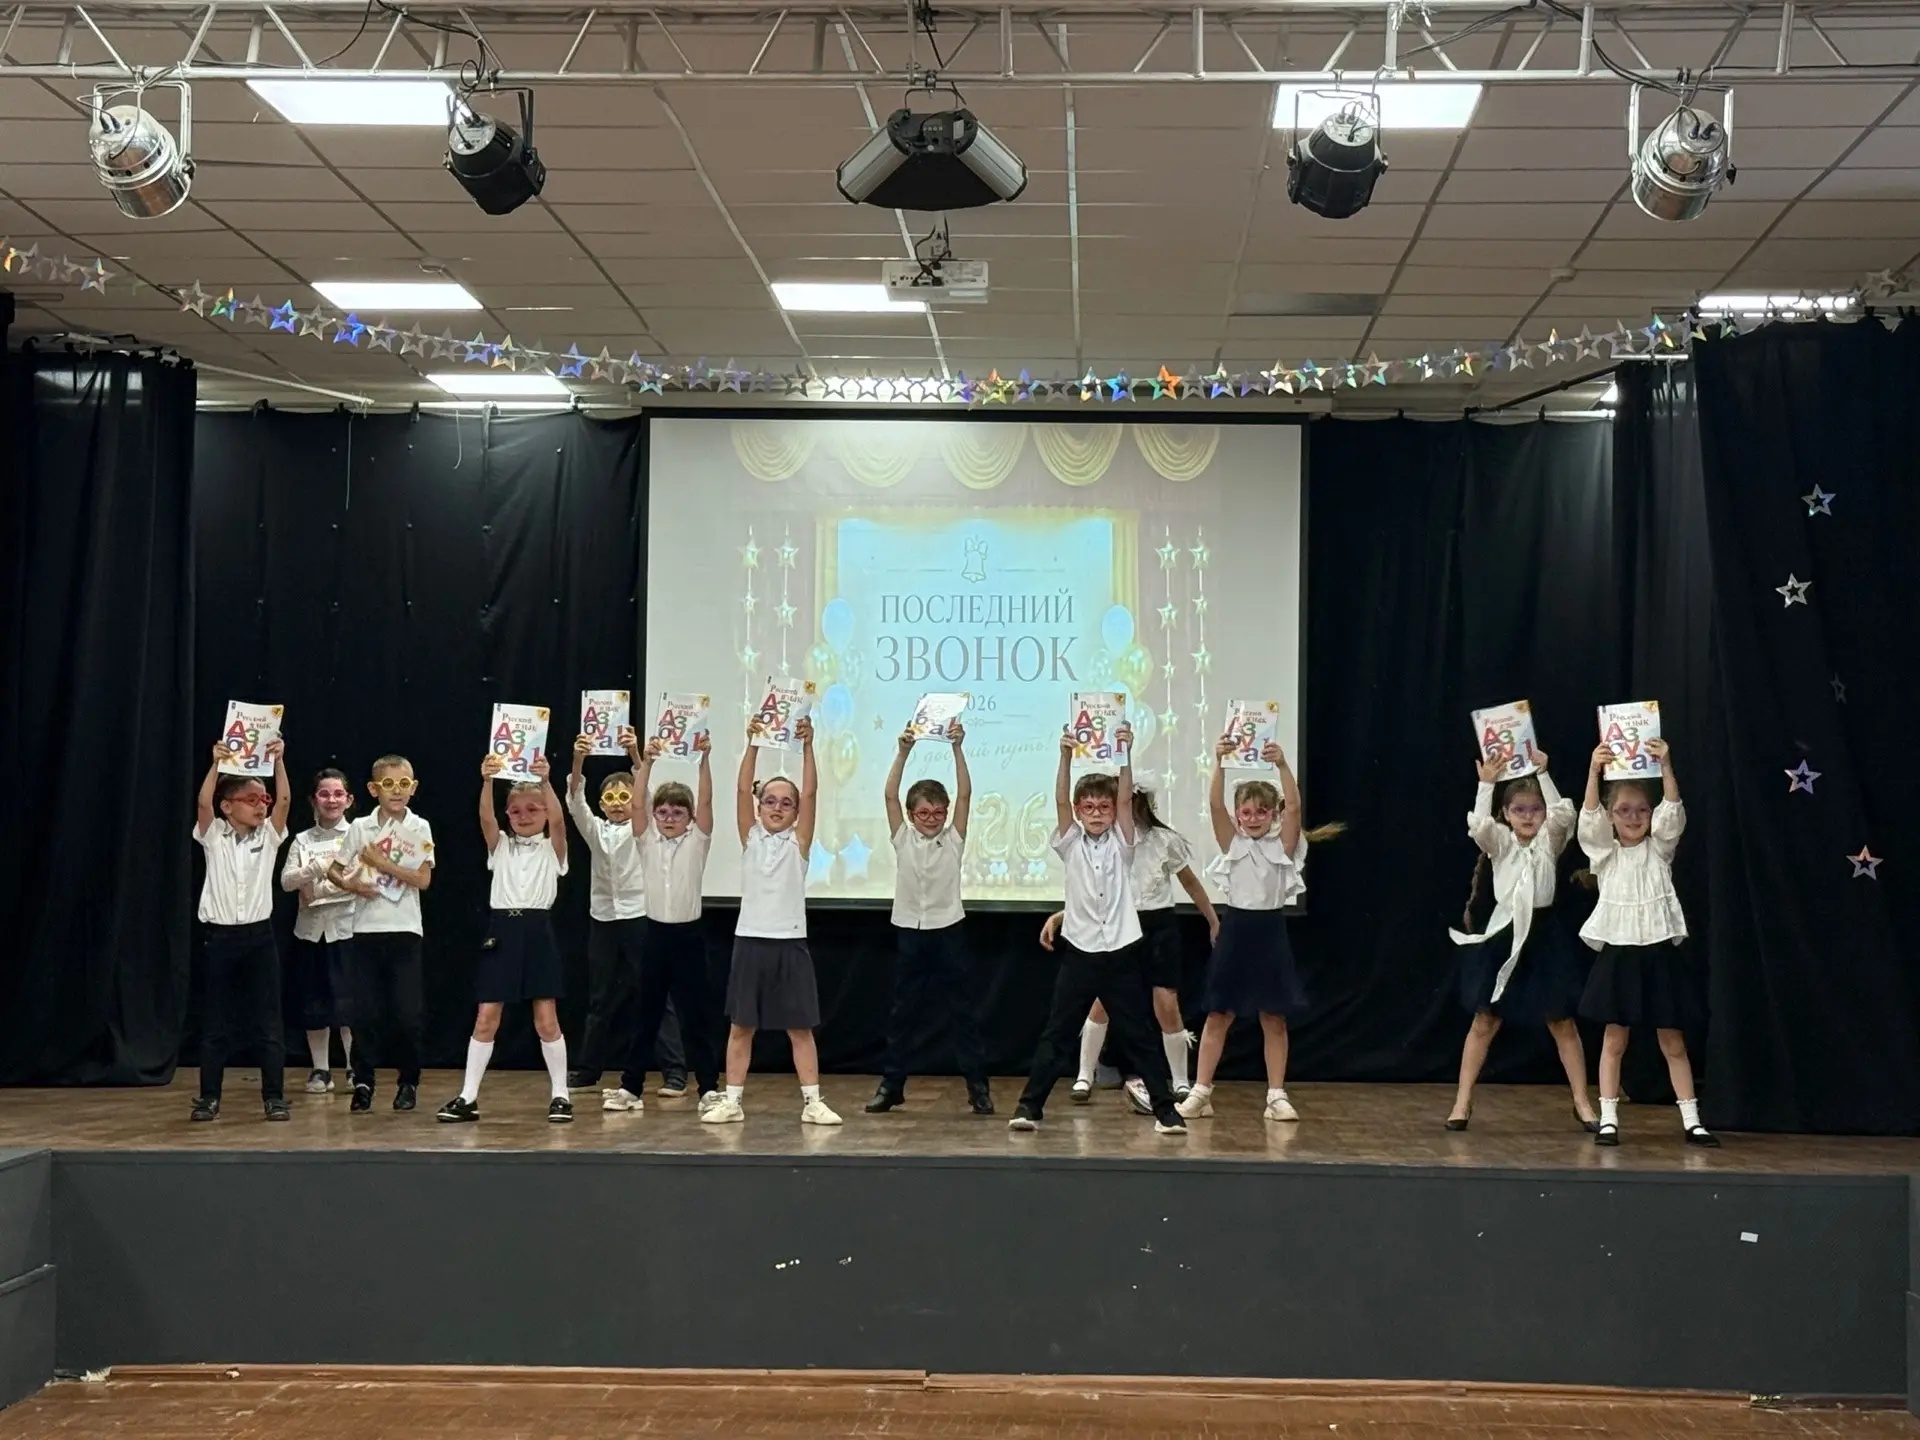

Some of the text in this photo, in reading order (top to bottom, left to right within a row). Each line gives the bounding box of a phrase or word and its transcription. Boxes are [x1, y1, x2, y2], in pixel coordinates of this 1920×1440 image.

[881, 588, 1074, 628] ПОСЛЕДНИЙ
[875, 635, 1079, 682] ЗВОНОК
[966, 694, 997, 711] 026
